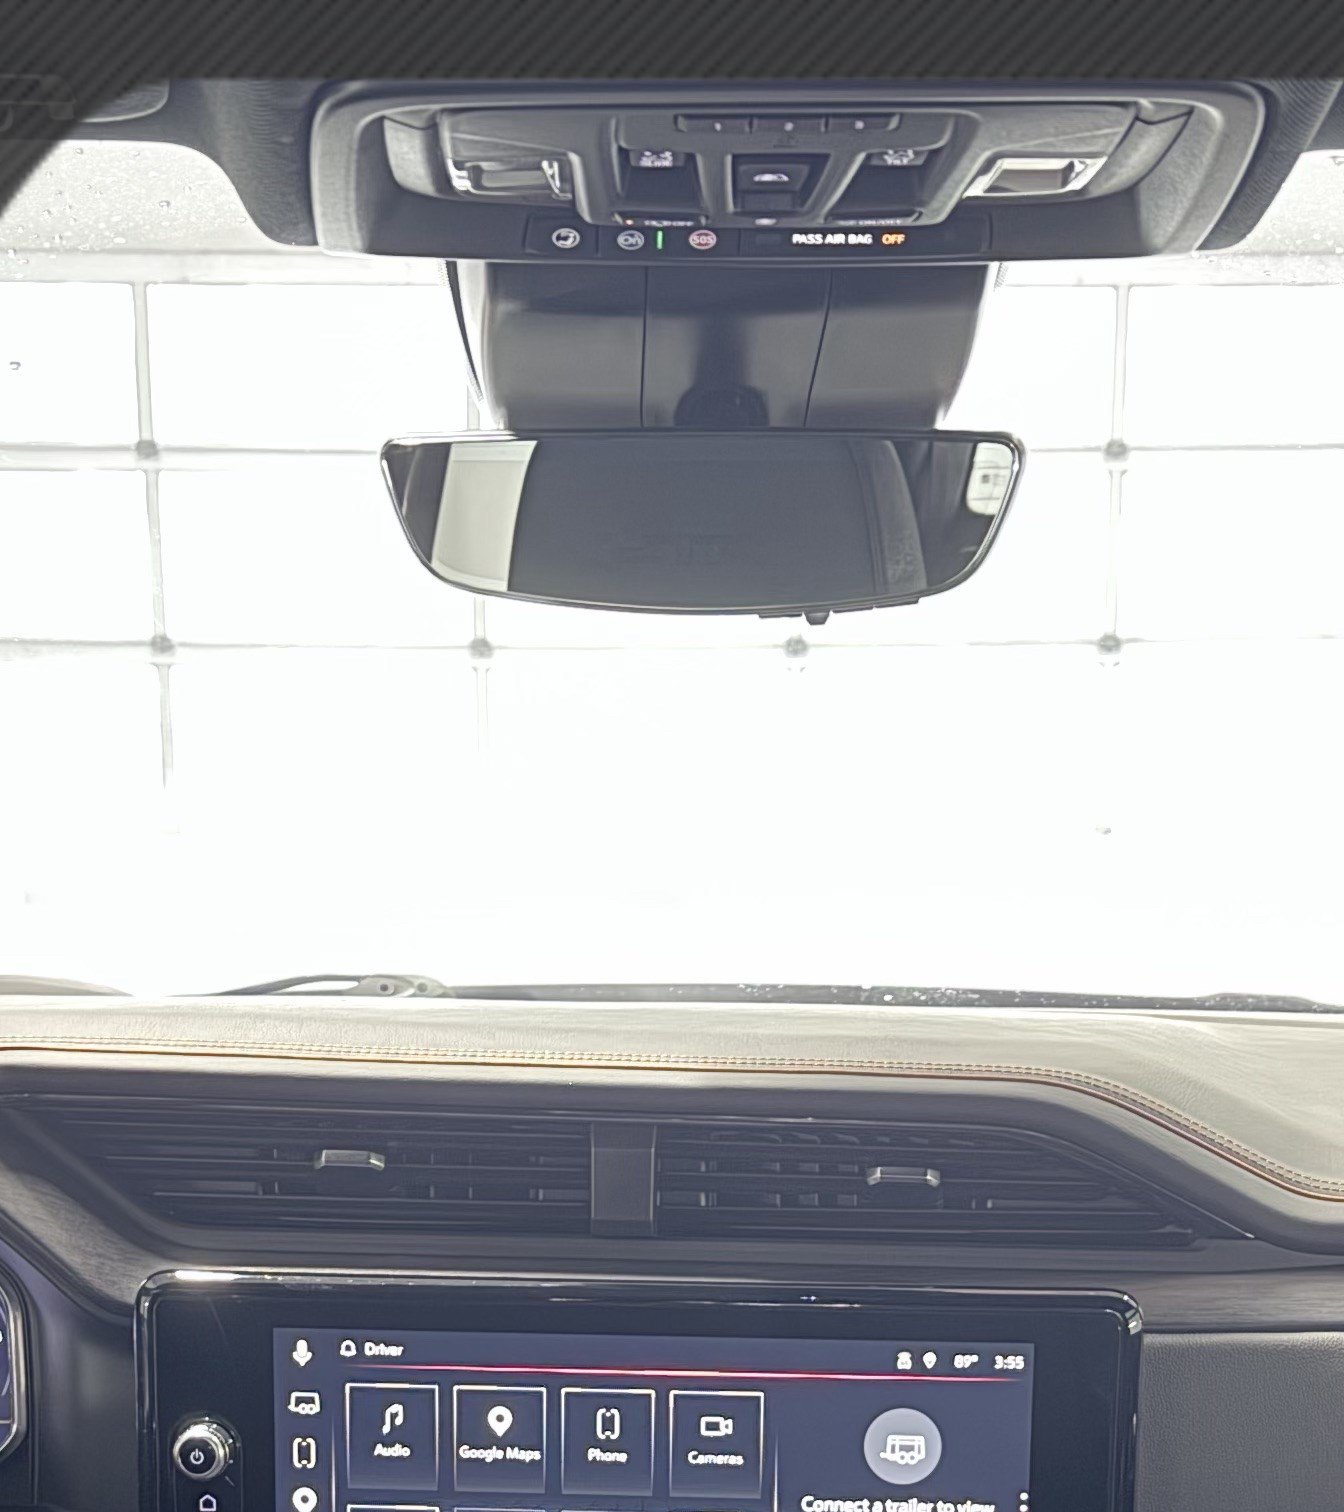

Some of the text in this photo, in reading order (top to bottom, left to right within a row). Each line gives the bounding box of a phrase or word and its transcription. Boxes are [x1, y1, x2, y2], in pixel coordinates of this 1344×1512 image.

[792, 233, 906, 245] PASS AIR BAG OFF
[364, 1342, 404, 1358] Driver
[994, 1354, 1025, 1370] 3:55
[373, 1443, 411, 1458] Audio
[458, 1445, 541, 1464] Google Maps
[587, 1448, 628, 1464] Phone
[687, 1451, 744, 1467] Cameras
